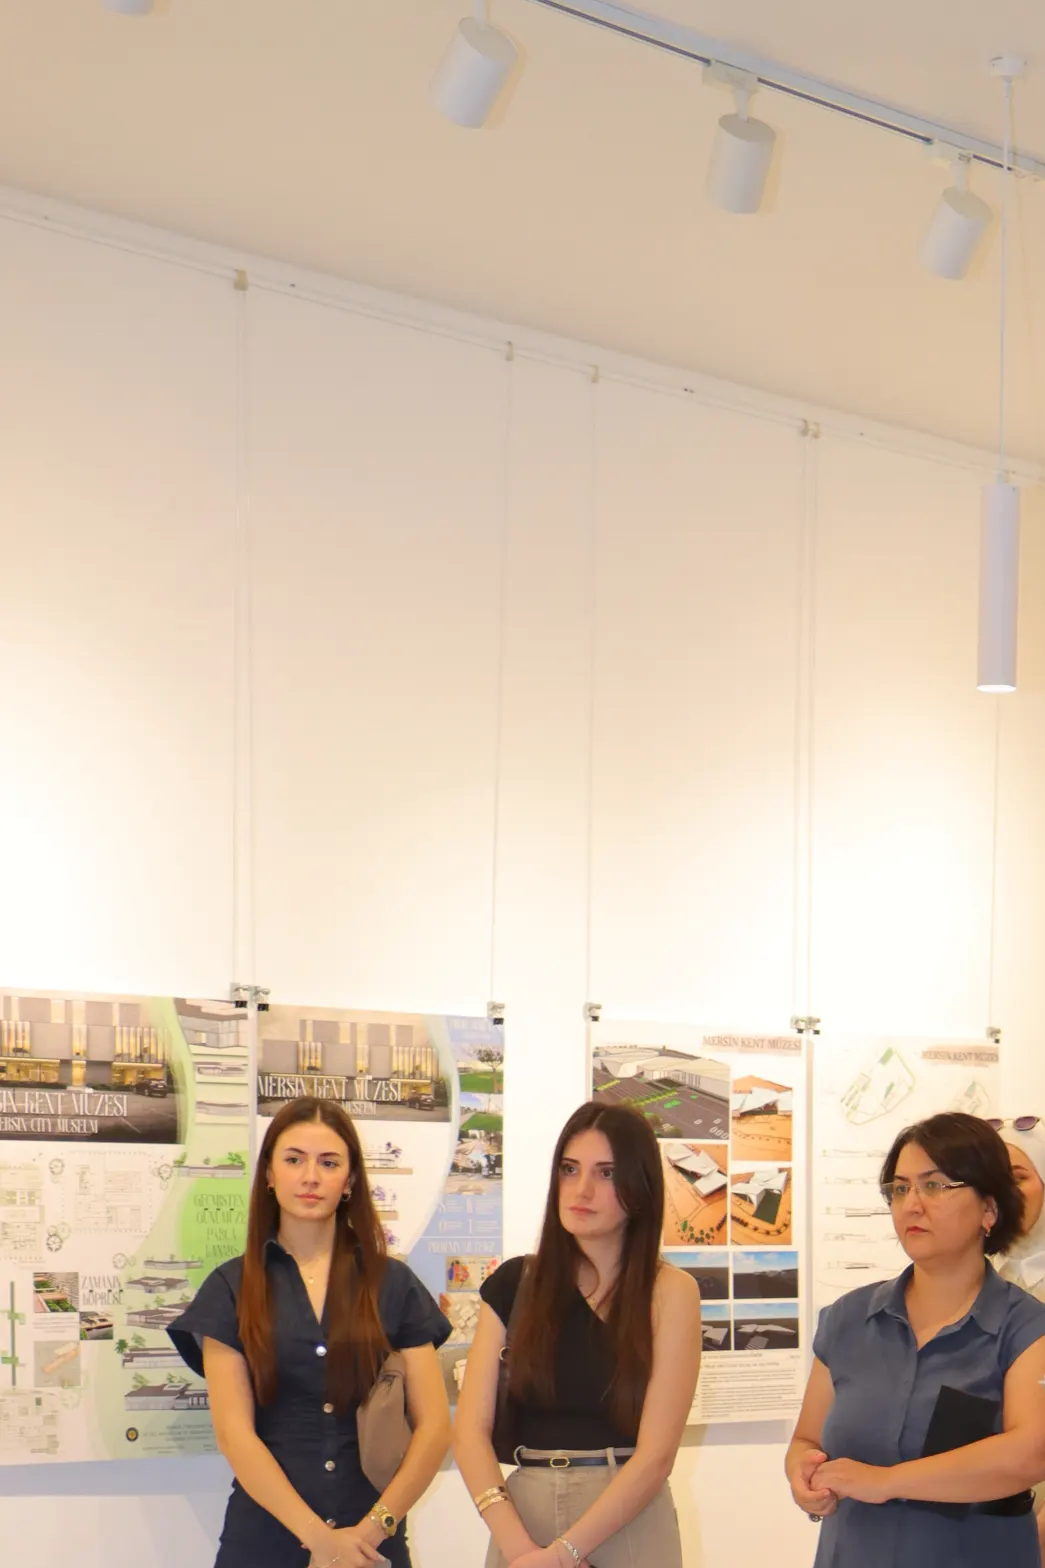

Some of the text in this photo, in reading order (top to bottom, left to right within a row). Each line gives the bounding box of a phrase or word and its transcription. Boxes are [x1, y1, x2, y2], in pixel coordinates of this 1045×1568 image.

[741, 1037, 766, 1049] KENT
[25, 1091, 68, 1114] KENT
[57, 1118, 98, 1134] MUSEUM
